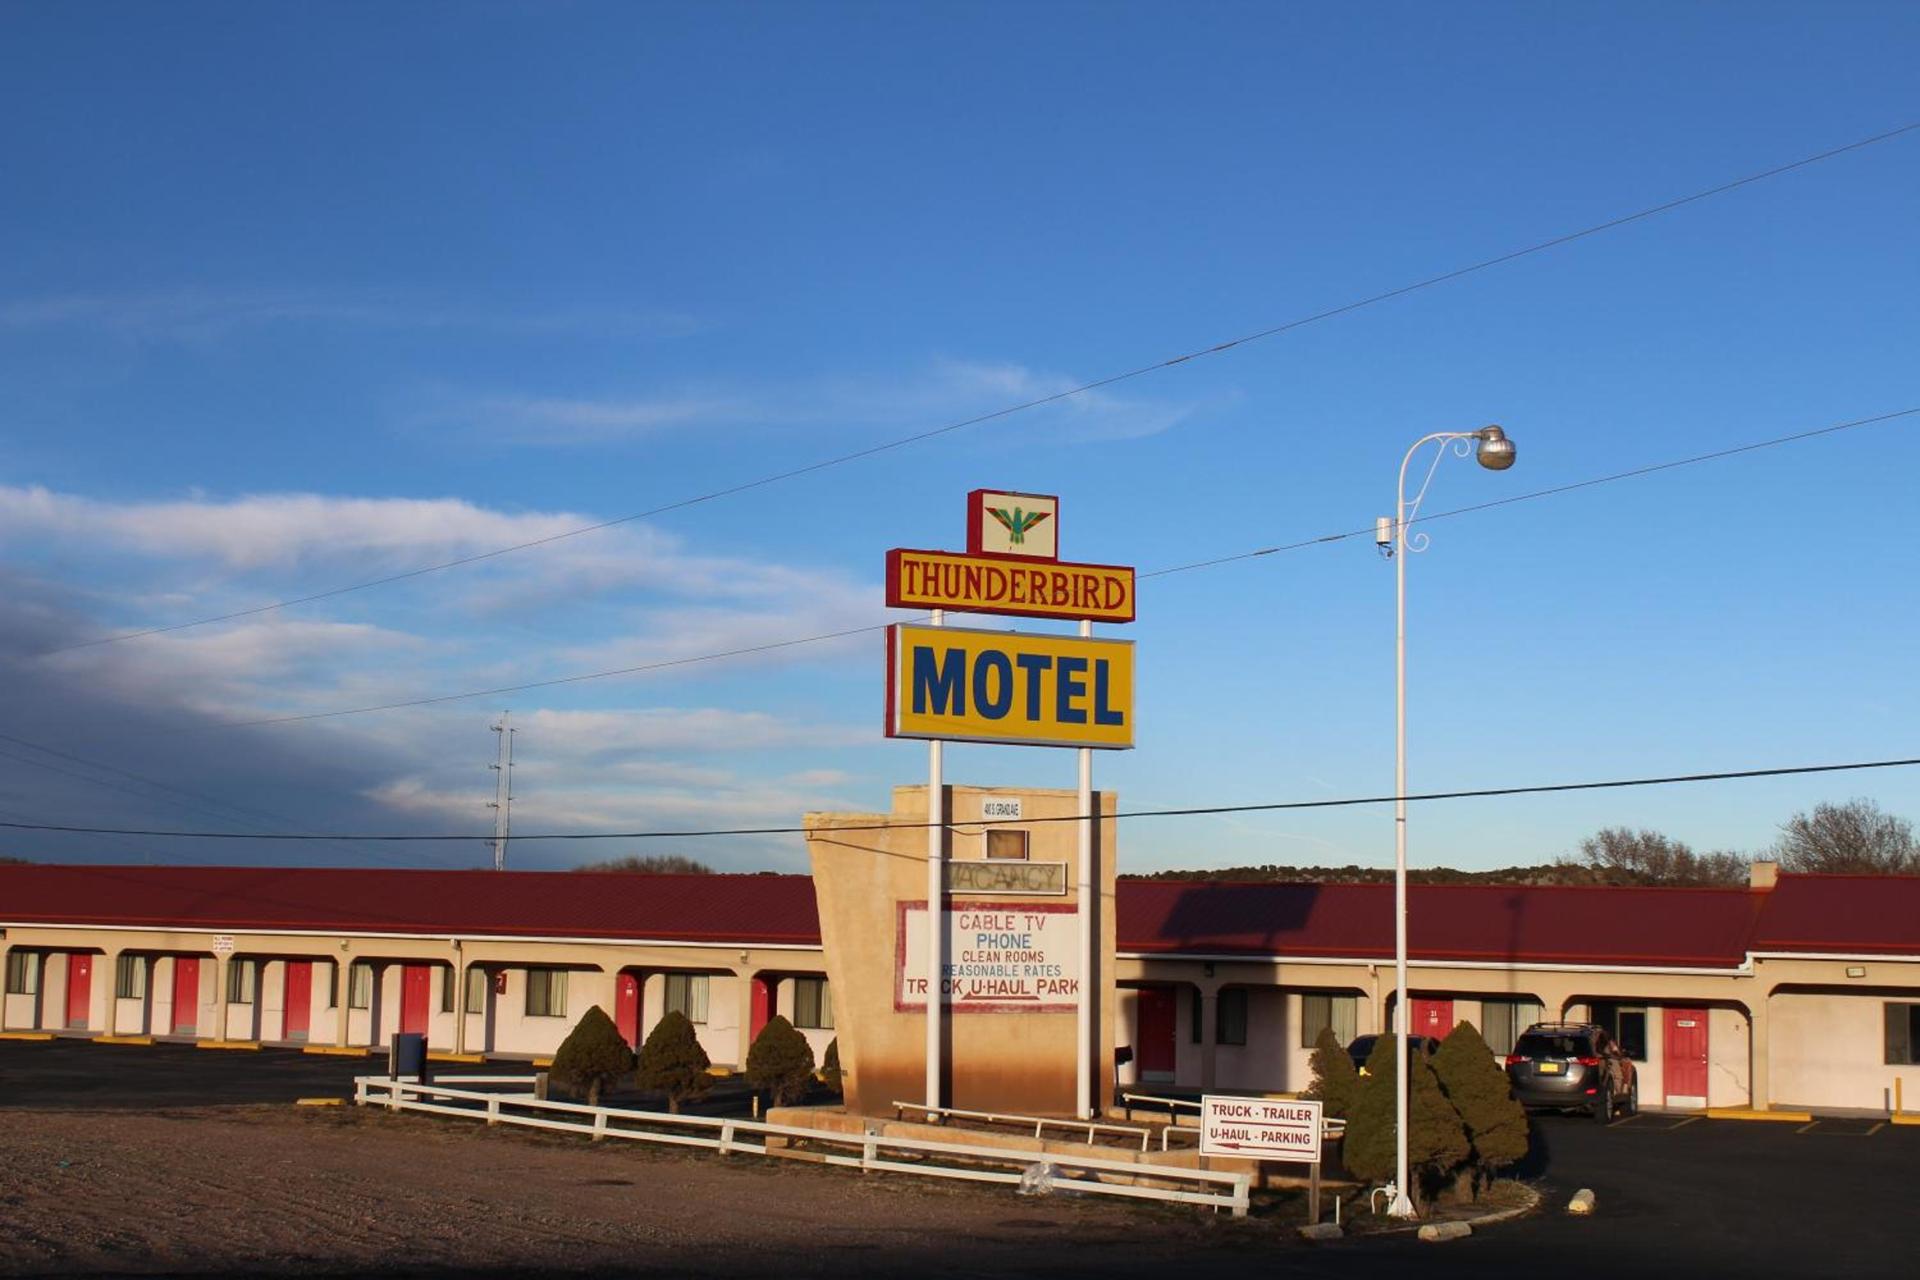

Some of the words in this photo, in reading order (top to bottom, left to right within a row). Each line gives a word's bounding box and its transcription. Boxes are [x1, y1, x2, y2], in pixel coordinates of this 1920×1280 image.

[903, 559, 1126, 611] THUNDERBIRD
[912, 645, 1124, 726] MOTEL
[945, 863, 1056, 891] VACANCY
[960, 914, 1015, 931] CABLE
[1024, 915, 1046, 931] TV
[976, 933, 1032, 949] PHONE
[962, 950, 1000, 963] CLEAN
[1005, 951, 1044, 963] ROOMS
[942, 964, 1018, 977] REASONABLE
[1024, 965, 1061, 976] RATES
[907, 978, 963, 994] TRCK
[1212, 1104, 1252, 1117] TRUCK
[1262, 1107, 1312, 1120] TRAILER
[1261, 1131, 1311, 1145] PARKING
